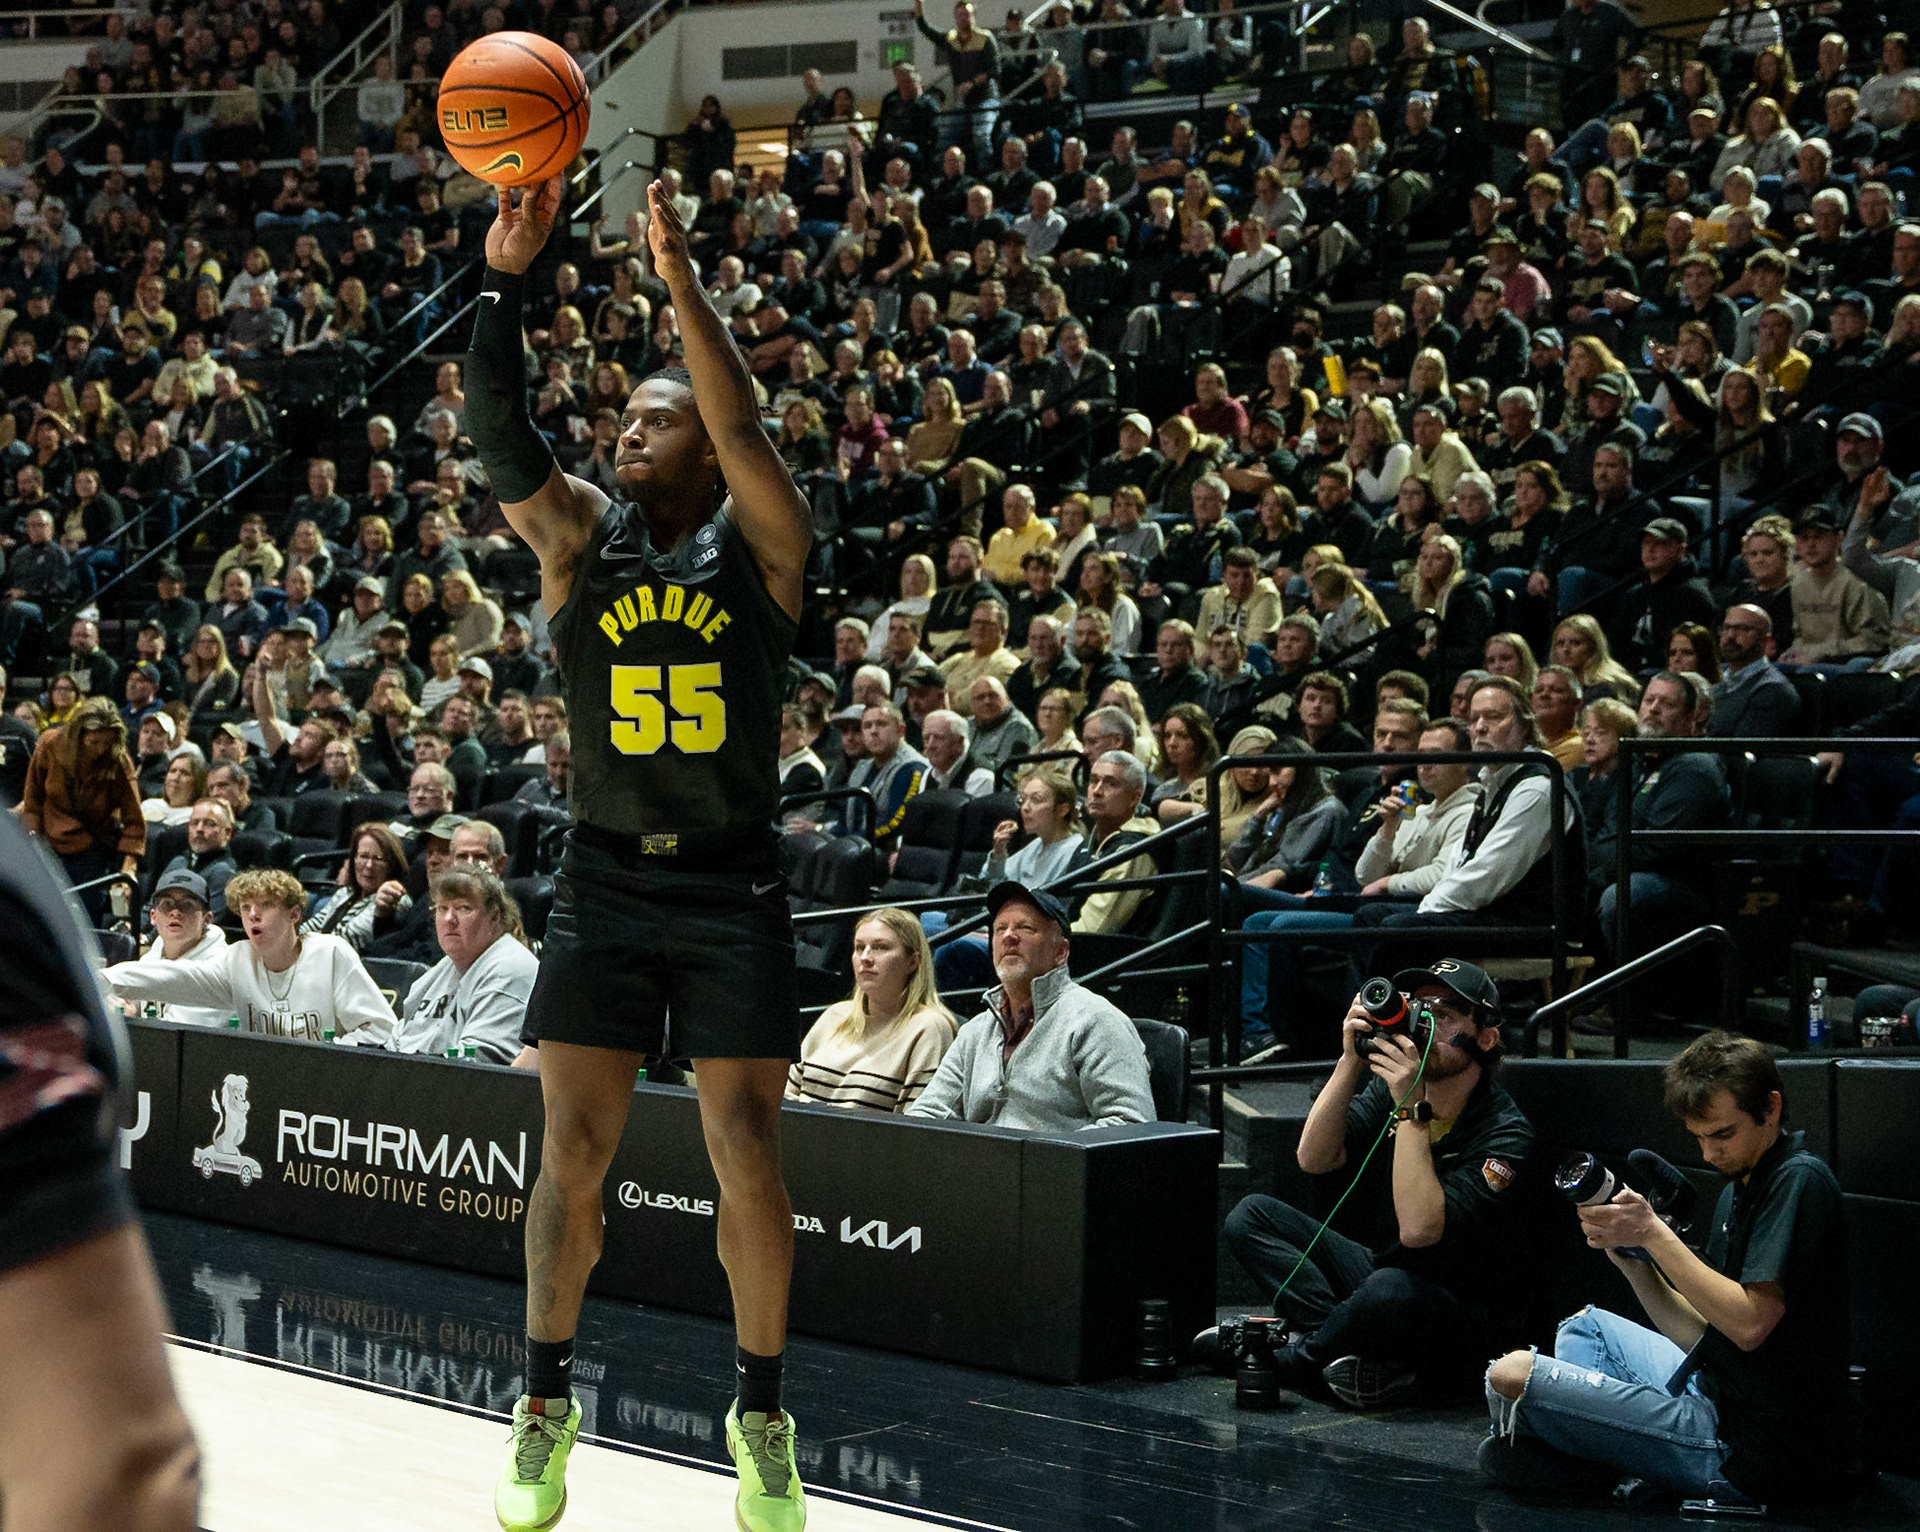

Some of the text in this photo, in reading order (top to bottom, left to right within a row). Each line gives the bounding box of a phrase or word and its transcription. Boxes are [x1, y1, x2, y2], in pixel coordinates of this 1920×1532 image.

[598, 584, 732, 647] PURDUE
[610, 661, 727, 755] 55
[277, 1109, 527, 1190] ROHRMAN
[283, 1160, 524, 1223] AUTOMOTIVE GROUP
[644, 1190, 714, 1216] LEXUS
